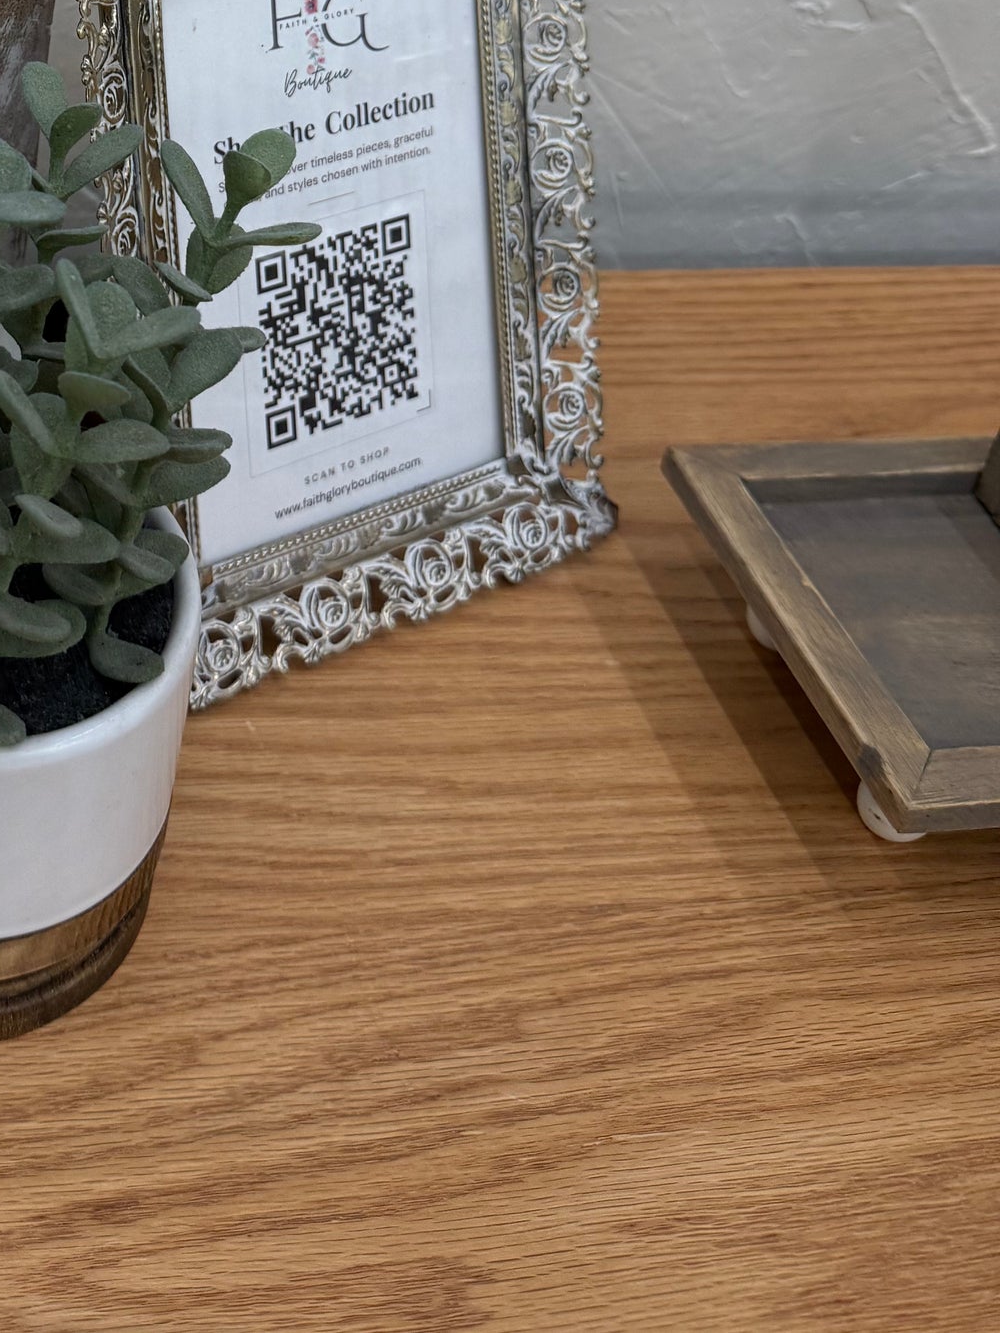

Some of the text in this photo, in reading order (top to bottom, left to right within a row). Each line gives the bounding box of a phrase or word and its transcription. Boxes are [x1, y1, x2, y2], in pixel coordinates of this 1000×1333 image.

[279, 19, 307, 30] FAITH
[323, 8, 355, 21] GLORY
[284, 65, 353, 97] Boutique
[279, 121, 316, 143] he
[325, 92, 435, 135] Collection
[311, 149, 353, 168] timeless
[356, 140, 392, 158] pieces,
[393, 126, 434, 148] graceful
[264, 185, 285, 199] and
[288, 175, 318, 193] styles
[321, 166, 359, 184] chosen
[361, 157, 383, 172] with
[385, 146, 431, 165] intention.
[304, 447, 390, 485] SCAN TO SHOP
[274, 456, 422, 519] www.faithgloryboutique.com
